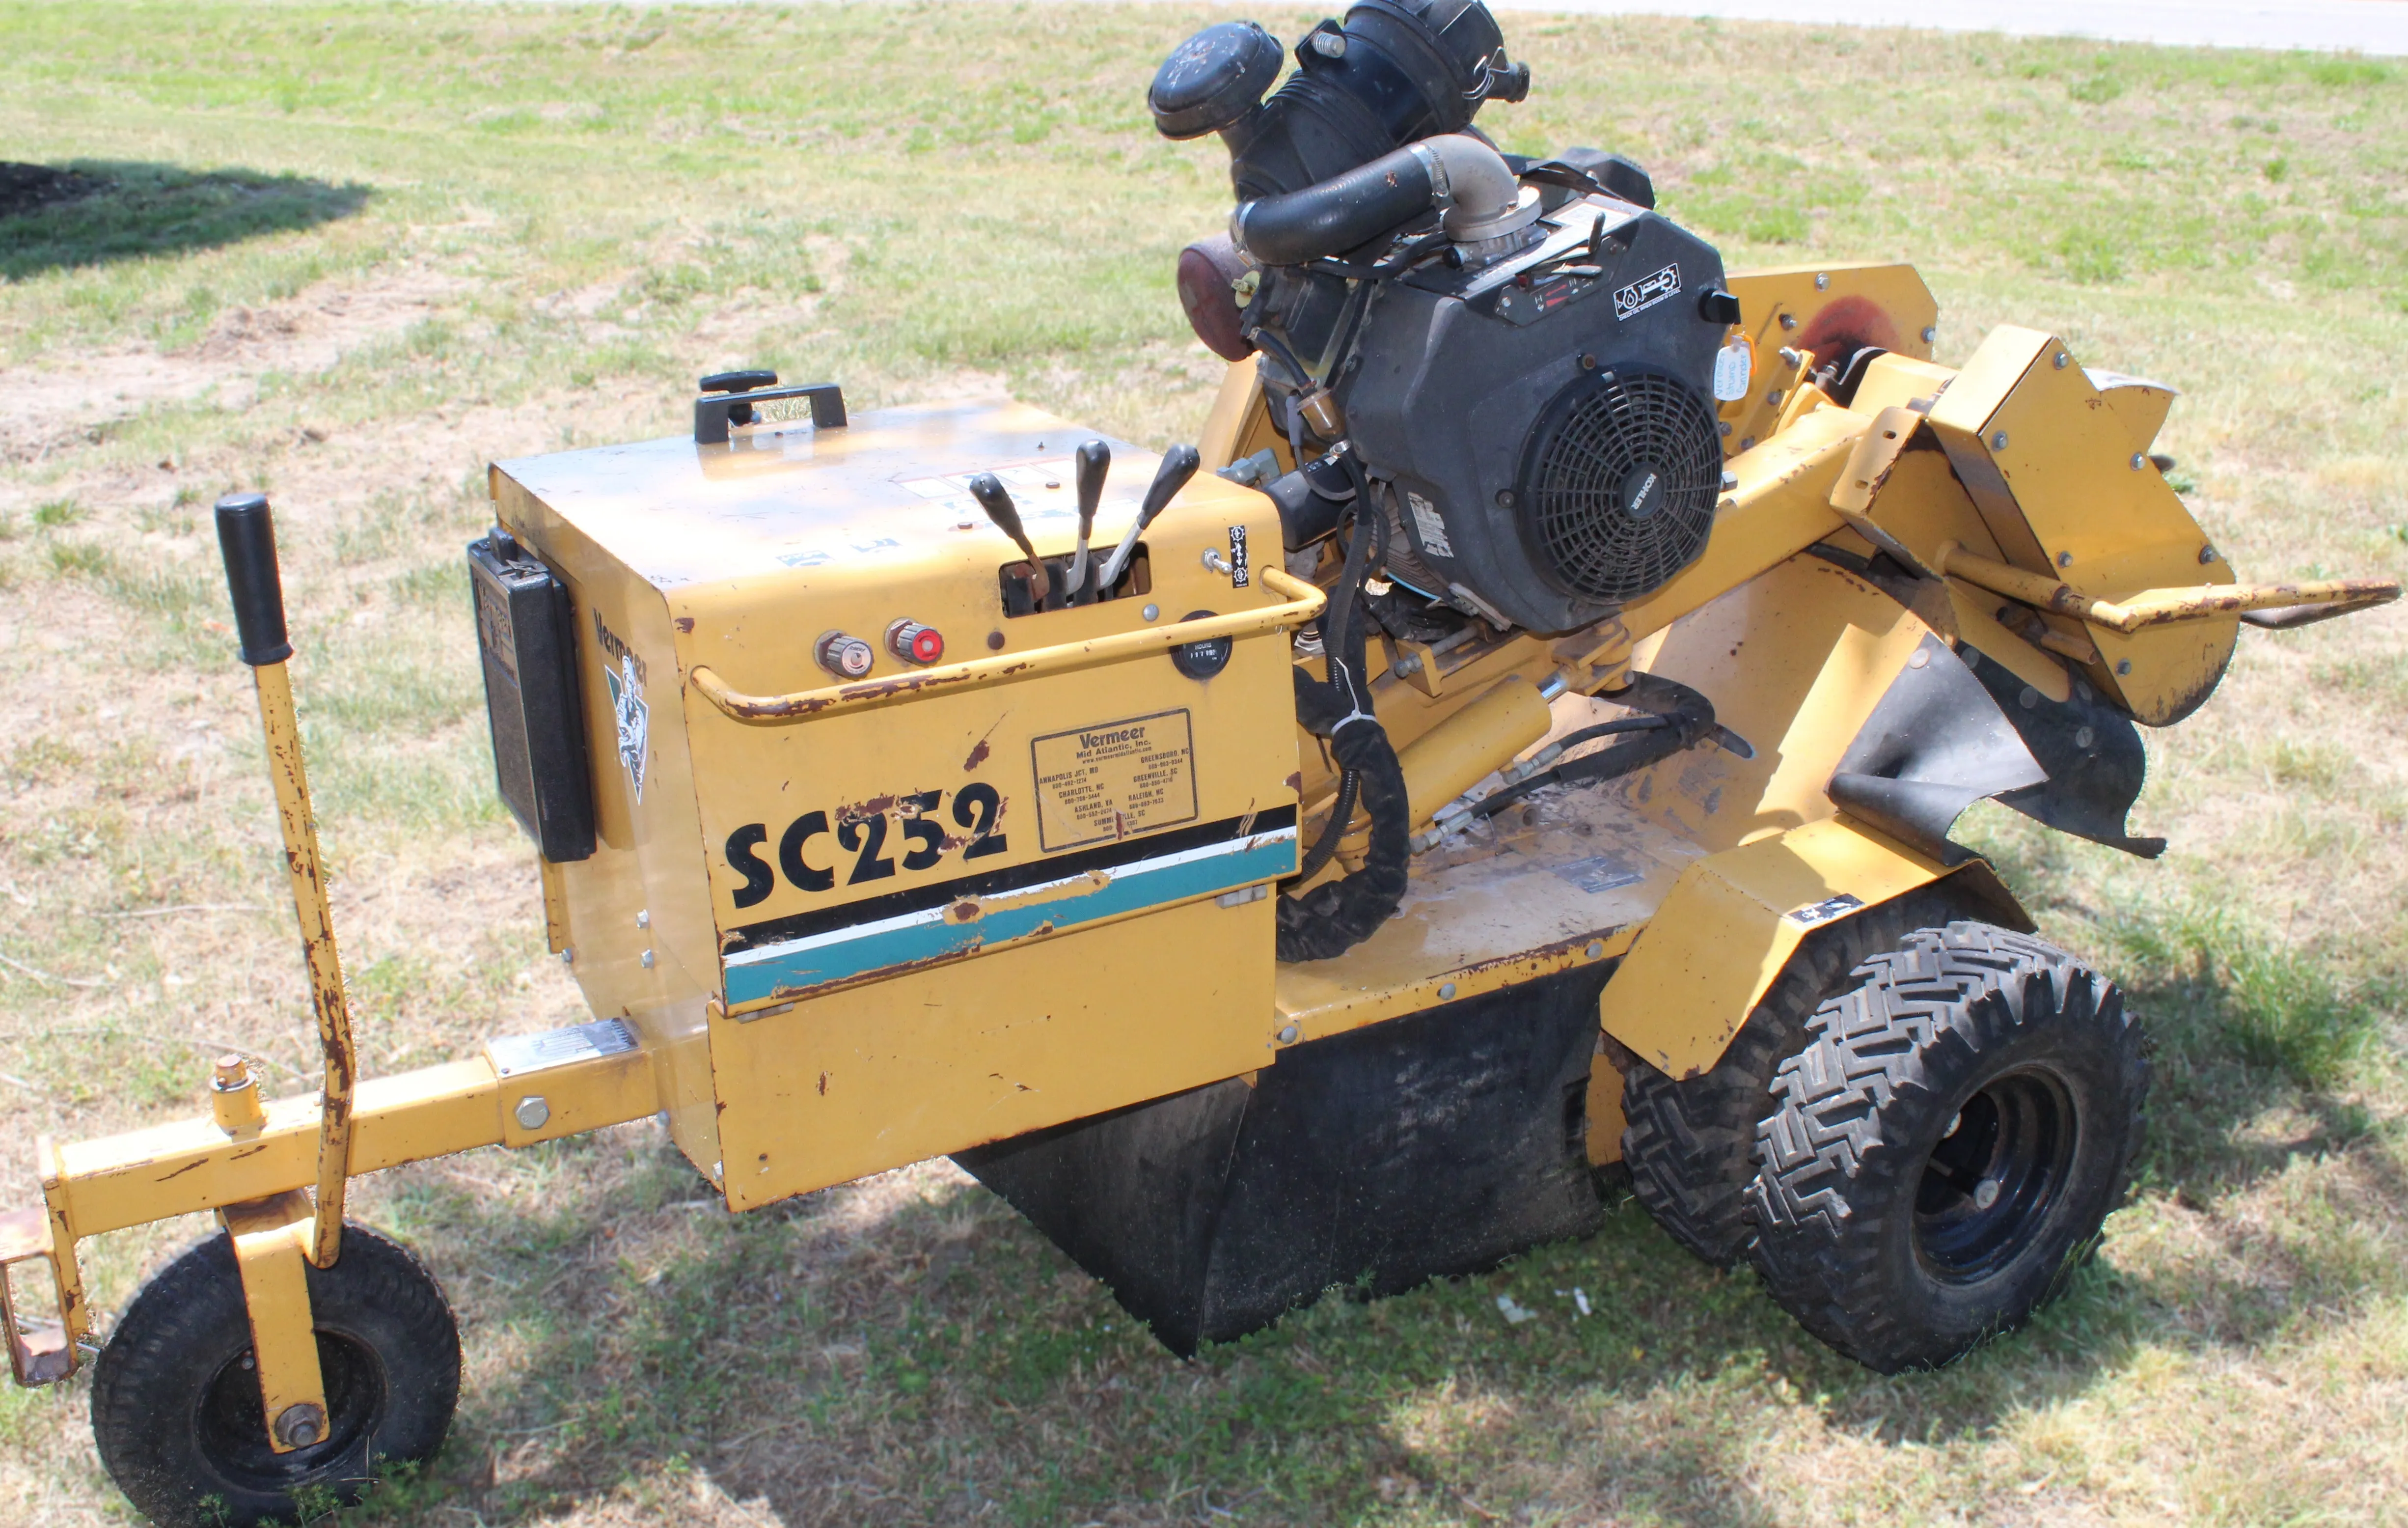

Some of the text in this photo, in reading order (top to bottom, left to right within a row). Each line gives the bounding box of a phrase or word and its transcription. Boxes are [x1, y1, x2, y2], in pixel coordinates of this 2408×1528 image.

[1619, 312, 1633, 321] CHECK
[1652, 297, 1664, 306] BOOM
[1631, 473, 1657, 509] KOHLER
[1079, 726, 1145, 749] Vermeer
[1076, 750, 1092, 759] Mid
[1095, 743, 1132, 755] Atlantic,
[1141, 750, 1179, 763] GREENSBORO,
[1039, 772, 1072, 784] ANNAPOLIS
[1133, 770, 1168, 782] GREENVILLE,
[1059, 786, 1094, 798] CHARLOTTE,
[1128, 791, 1154, 802] RALEIGH,
[1074, 802, 1103, 813] ASHLAND,
[725, 782, 1008, 910] SC252
